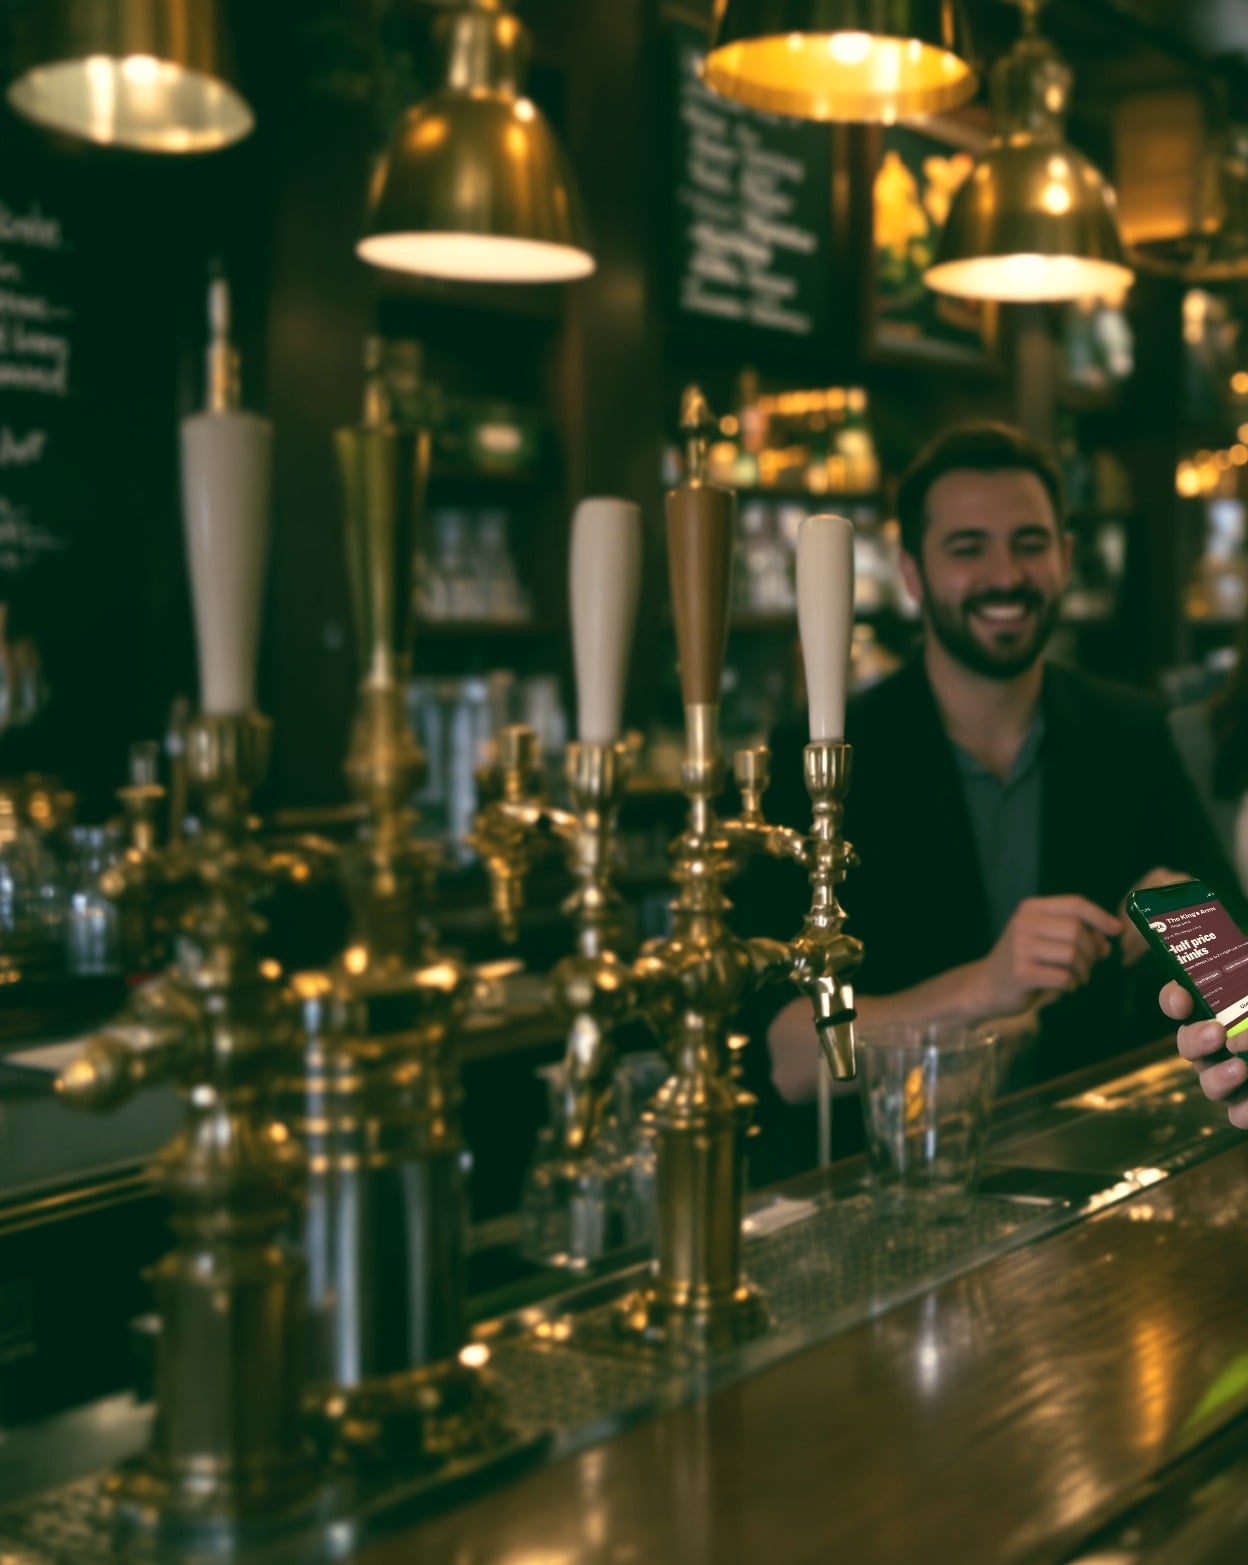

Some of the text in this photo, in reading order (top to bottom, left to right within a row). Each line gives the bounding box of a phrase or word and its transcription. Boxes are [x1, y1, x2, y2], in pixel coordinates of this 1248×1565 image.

[1166, 916, 1181, 924] The
[1180, 911, 1200, 920] King's
[1200, 906, 1216, 914] Arms
[1190, 932, 1217, 948] price
